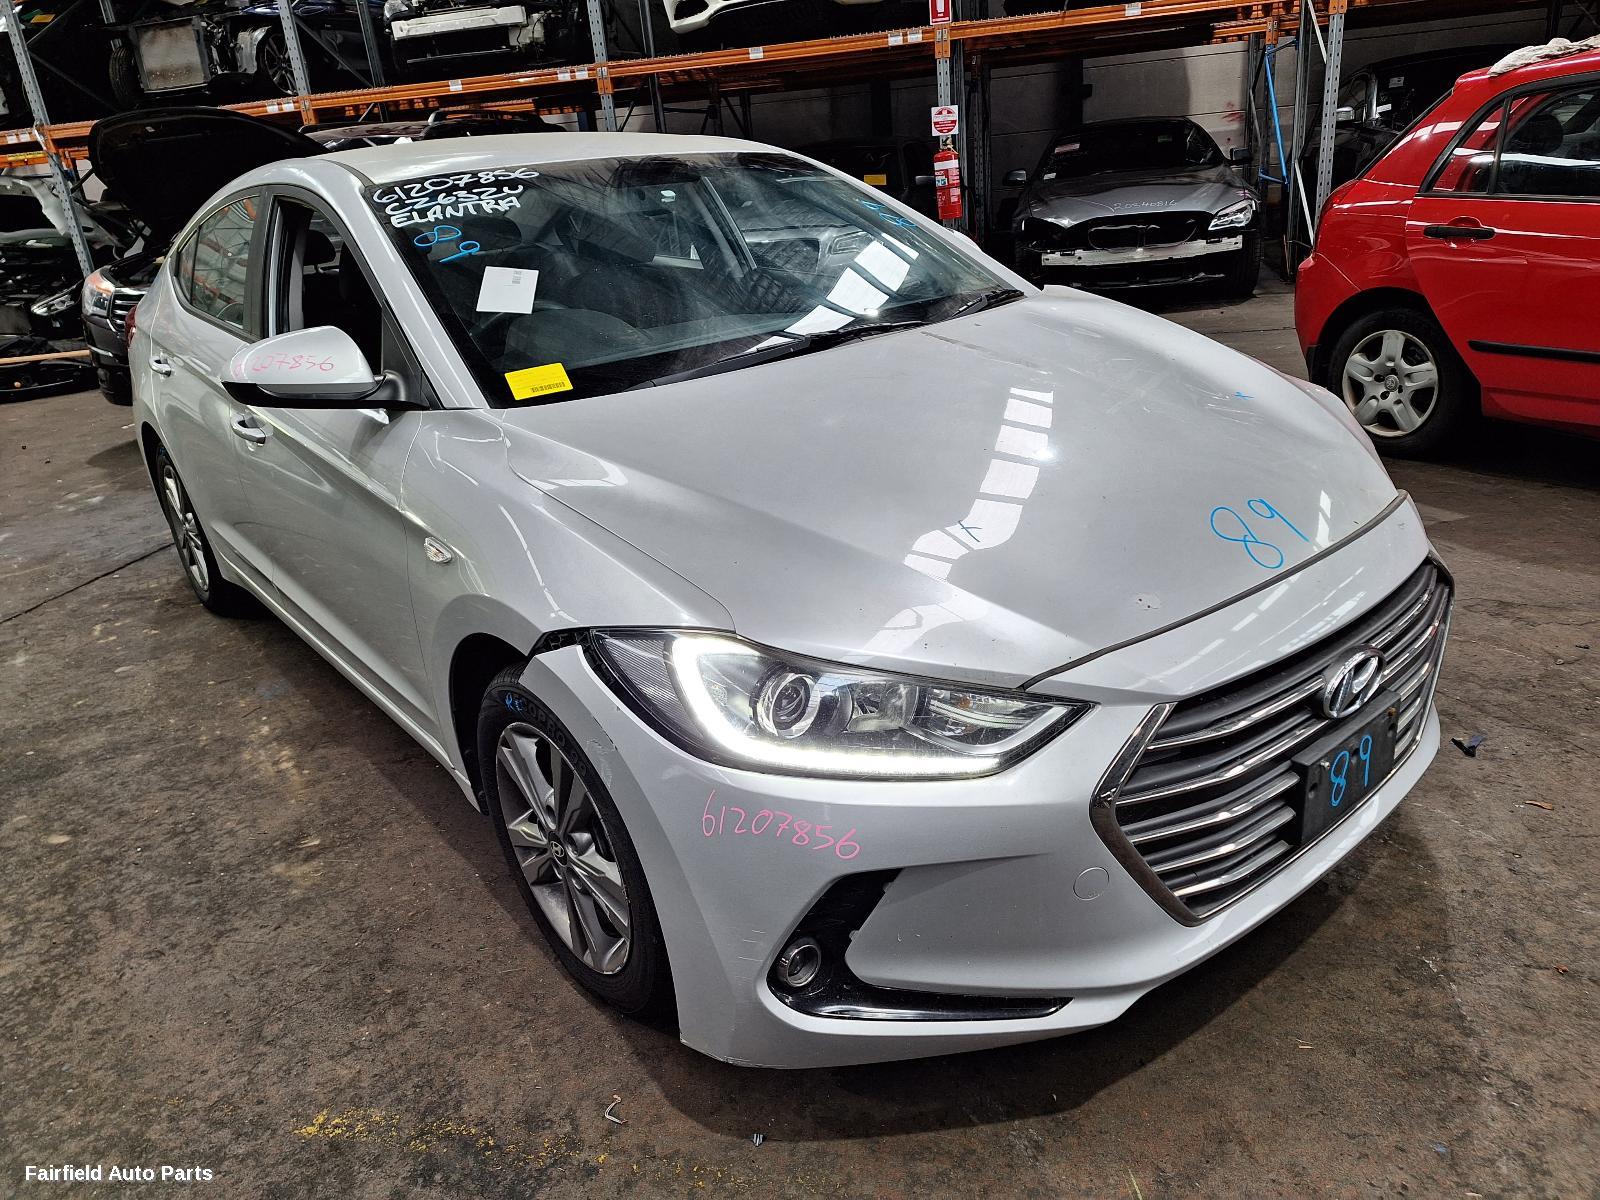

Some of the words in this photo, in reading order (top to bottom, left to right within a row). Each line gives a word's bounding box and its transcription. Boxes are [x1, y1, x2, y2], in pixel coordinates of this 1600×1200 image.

[373, 167, 540, 203] 61207856
[390, 196, 521, 228] ELANTRA
[413, 225, 481, 263] 89
[1210, 498, 1310, 570] 89
[1330, 734, 1372, 807] 89
[701, 789, 861, 860] 61207856
